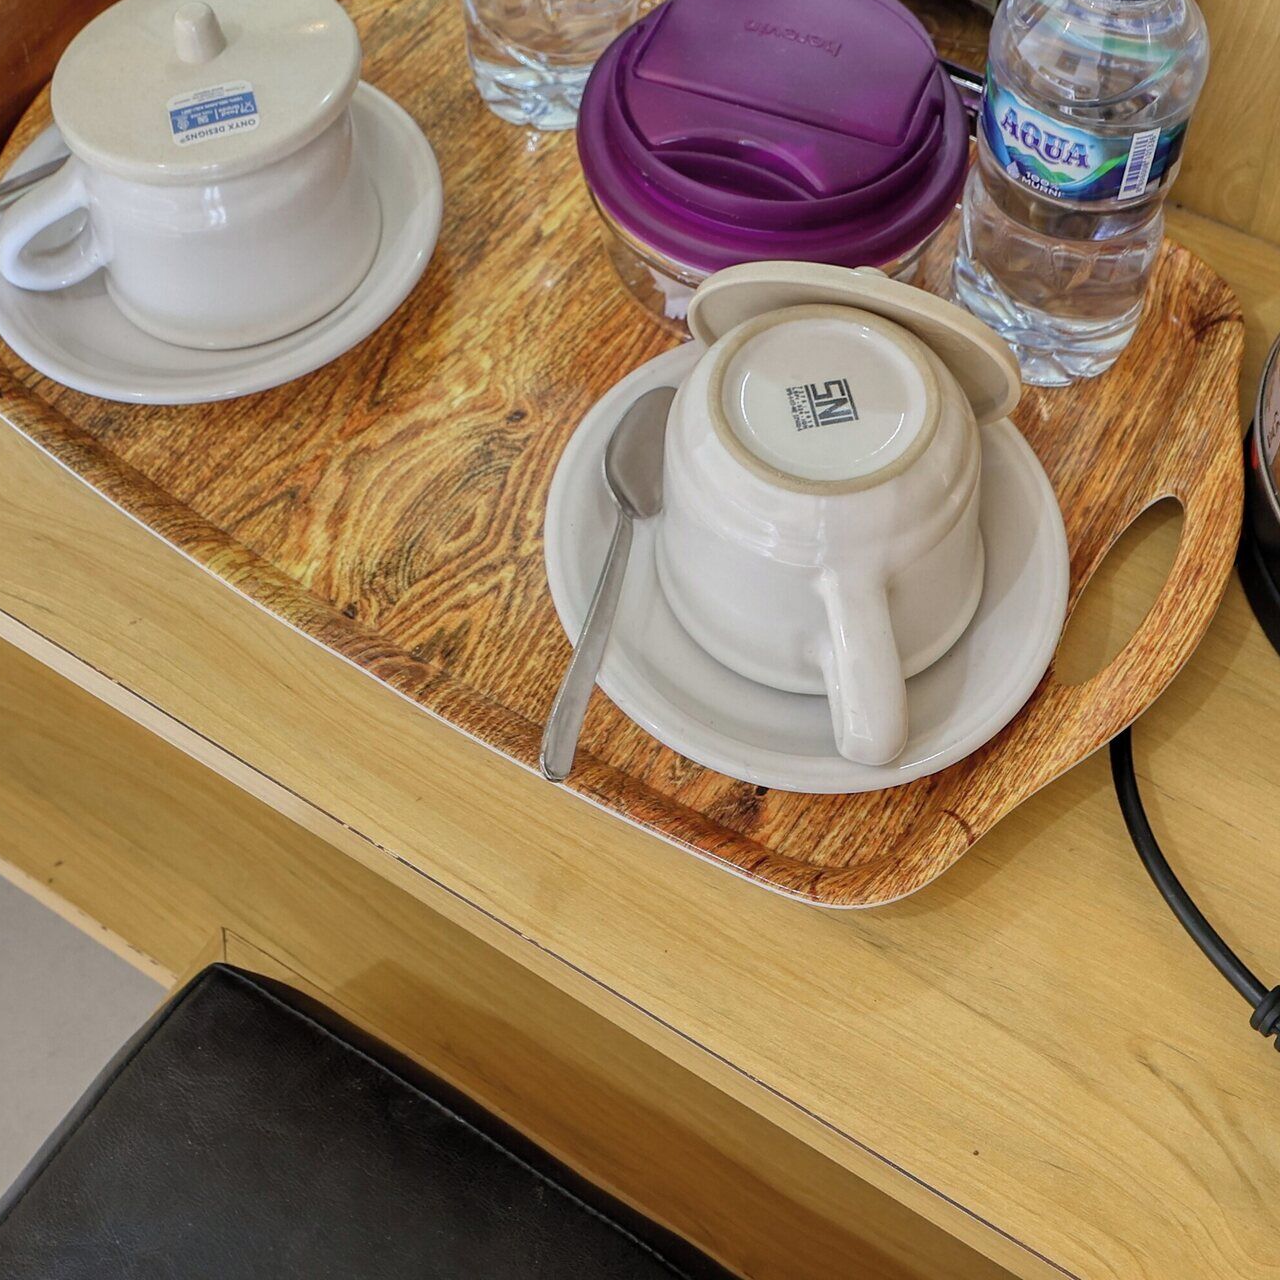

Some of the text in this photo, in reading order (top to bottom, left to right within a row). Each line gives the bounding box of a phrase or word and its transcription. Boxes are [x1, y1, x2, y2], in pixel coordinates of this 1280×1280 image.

[228, 119, 256, 130] ONYX
[1001, 107, 1091, 169] AQUA
[810, 380, 853, 426] SNI
